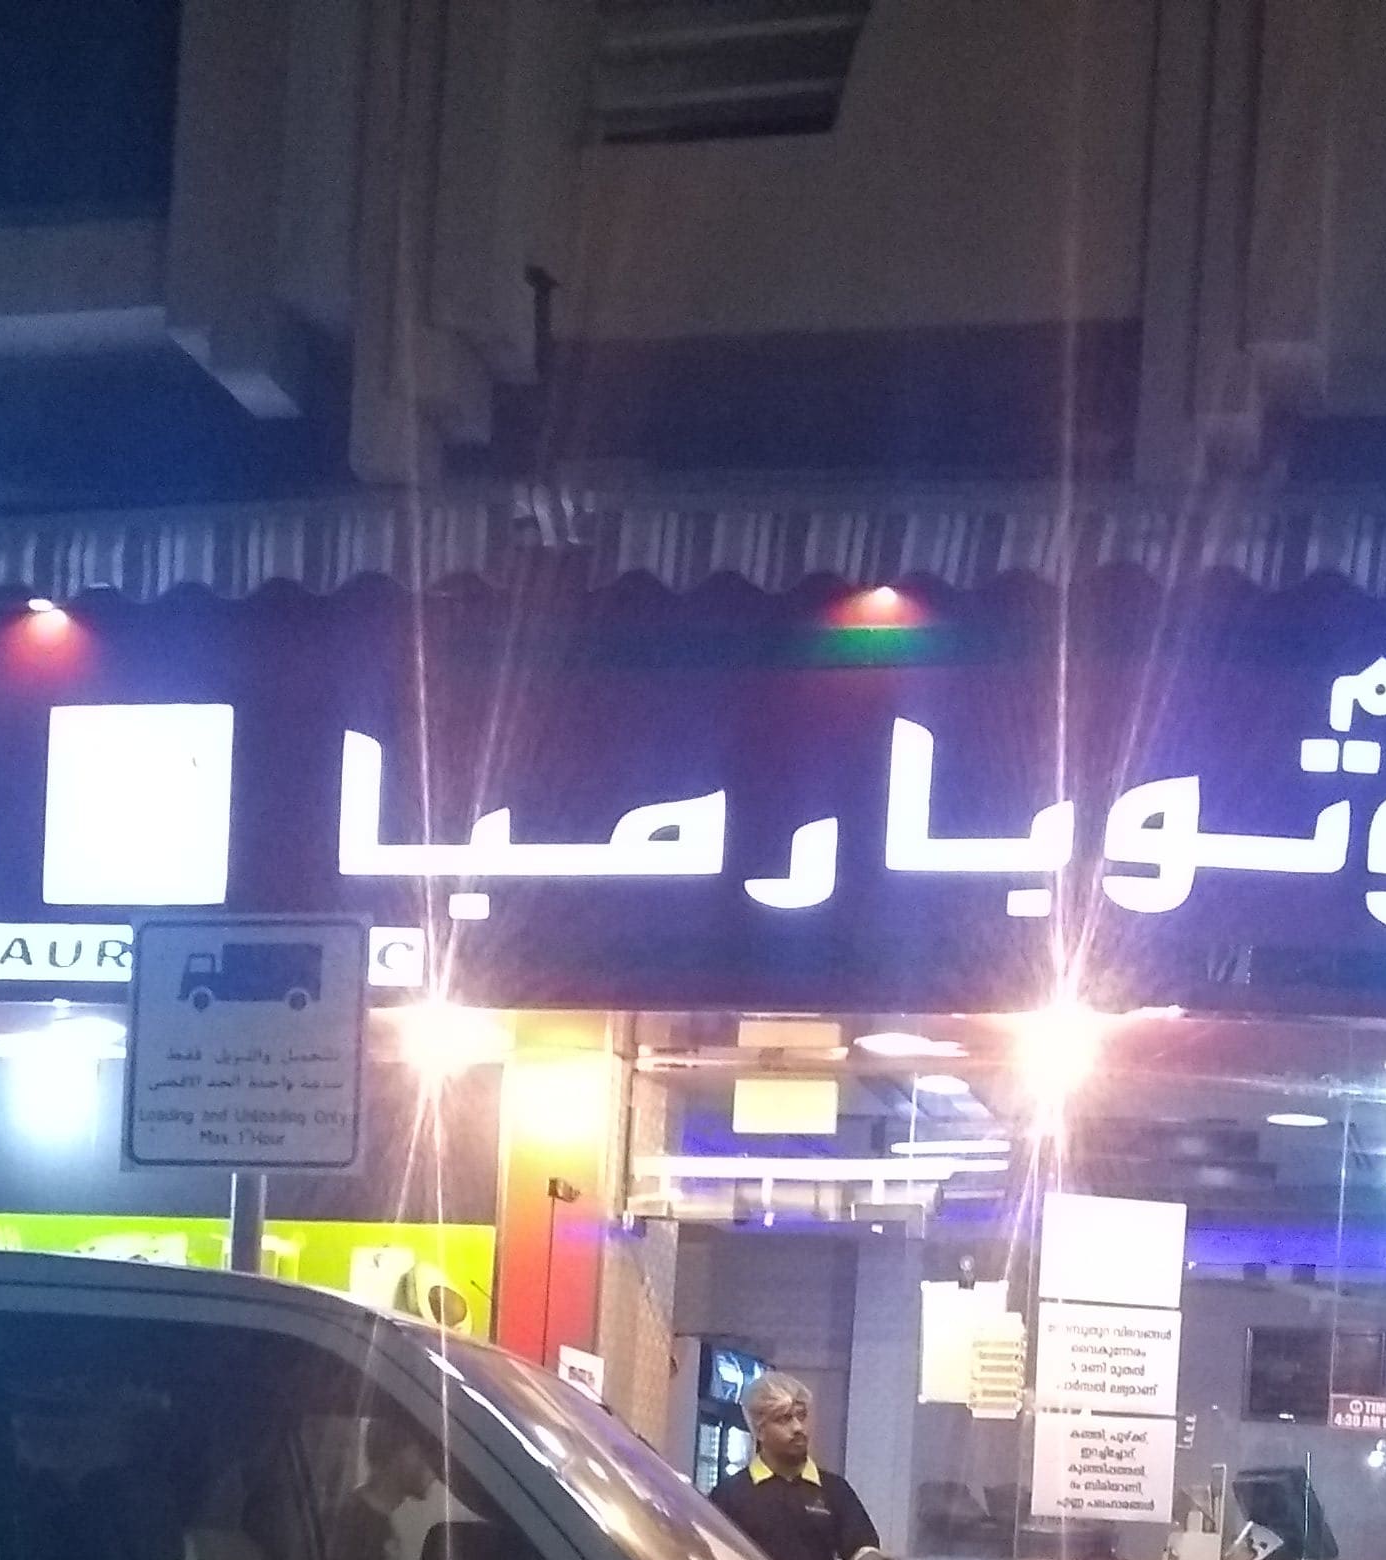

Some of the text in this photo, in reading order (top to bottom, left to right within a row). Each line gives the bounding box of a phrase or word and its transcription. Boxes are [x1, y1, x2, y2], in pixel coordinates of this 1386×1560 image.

[138, 1107, 348, 1129] Loading and Unloading Only
[251, 1130, 286, 1147] Hour
[1362, 1414, 1381, 1429] AM
